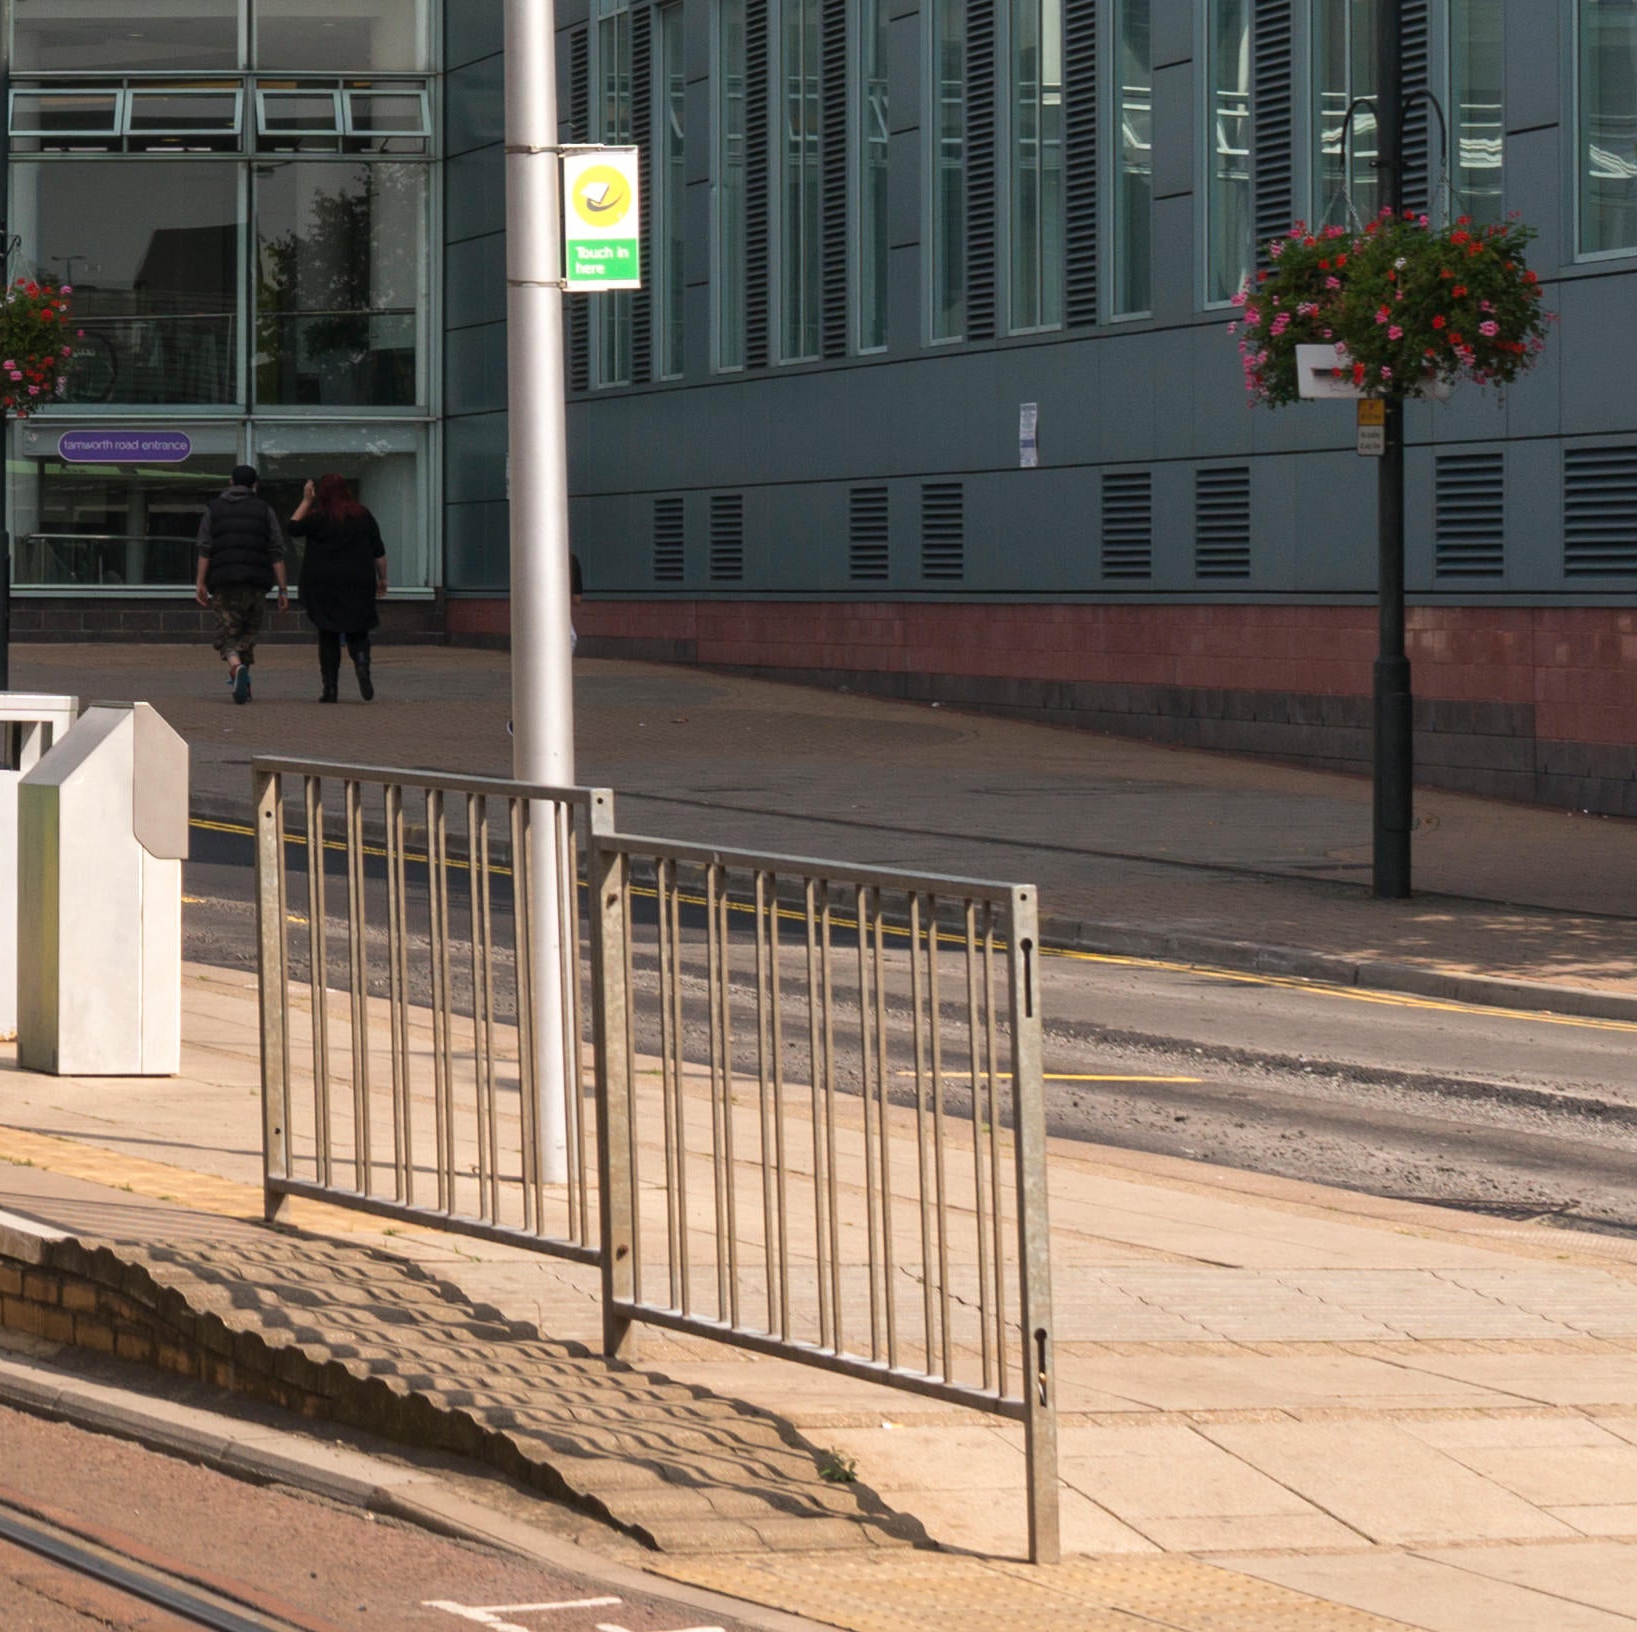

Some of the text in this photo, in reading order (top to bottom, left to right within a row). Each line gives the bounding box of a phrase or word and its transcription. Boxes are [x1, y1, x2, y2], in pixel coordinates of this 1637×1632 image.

[575, 246, 629, 258] Touch in
[575, 262, 605, 274] here
[64, 440, 188, 450] tamworth road entrance
